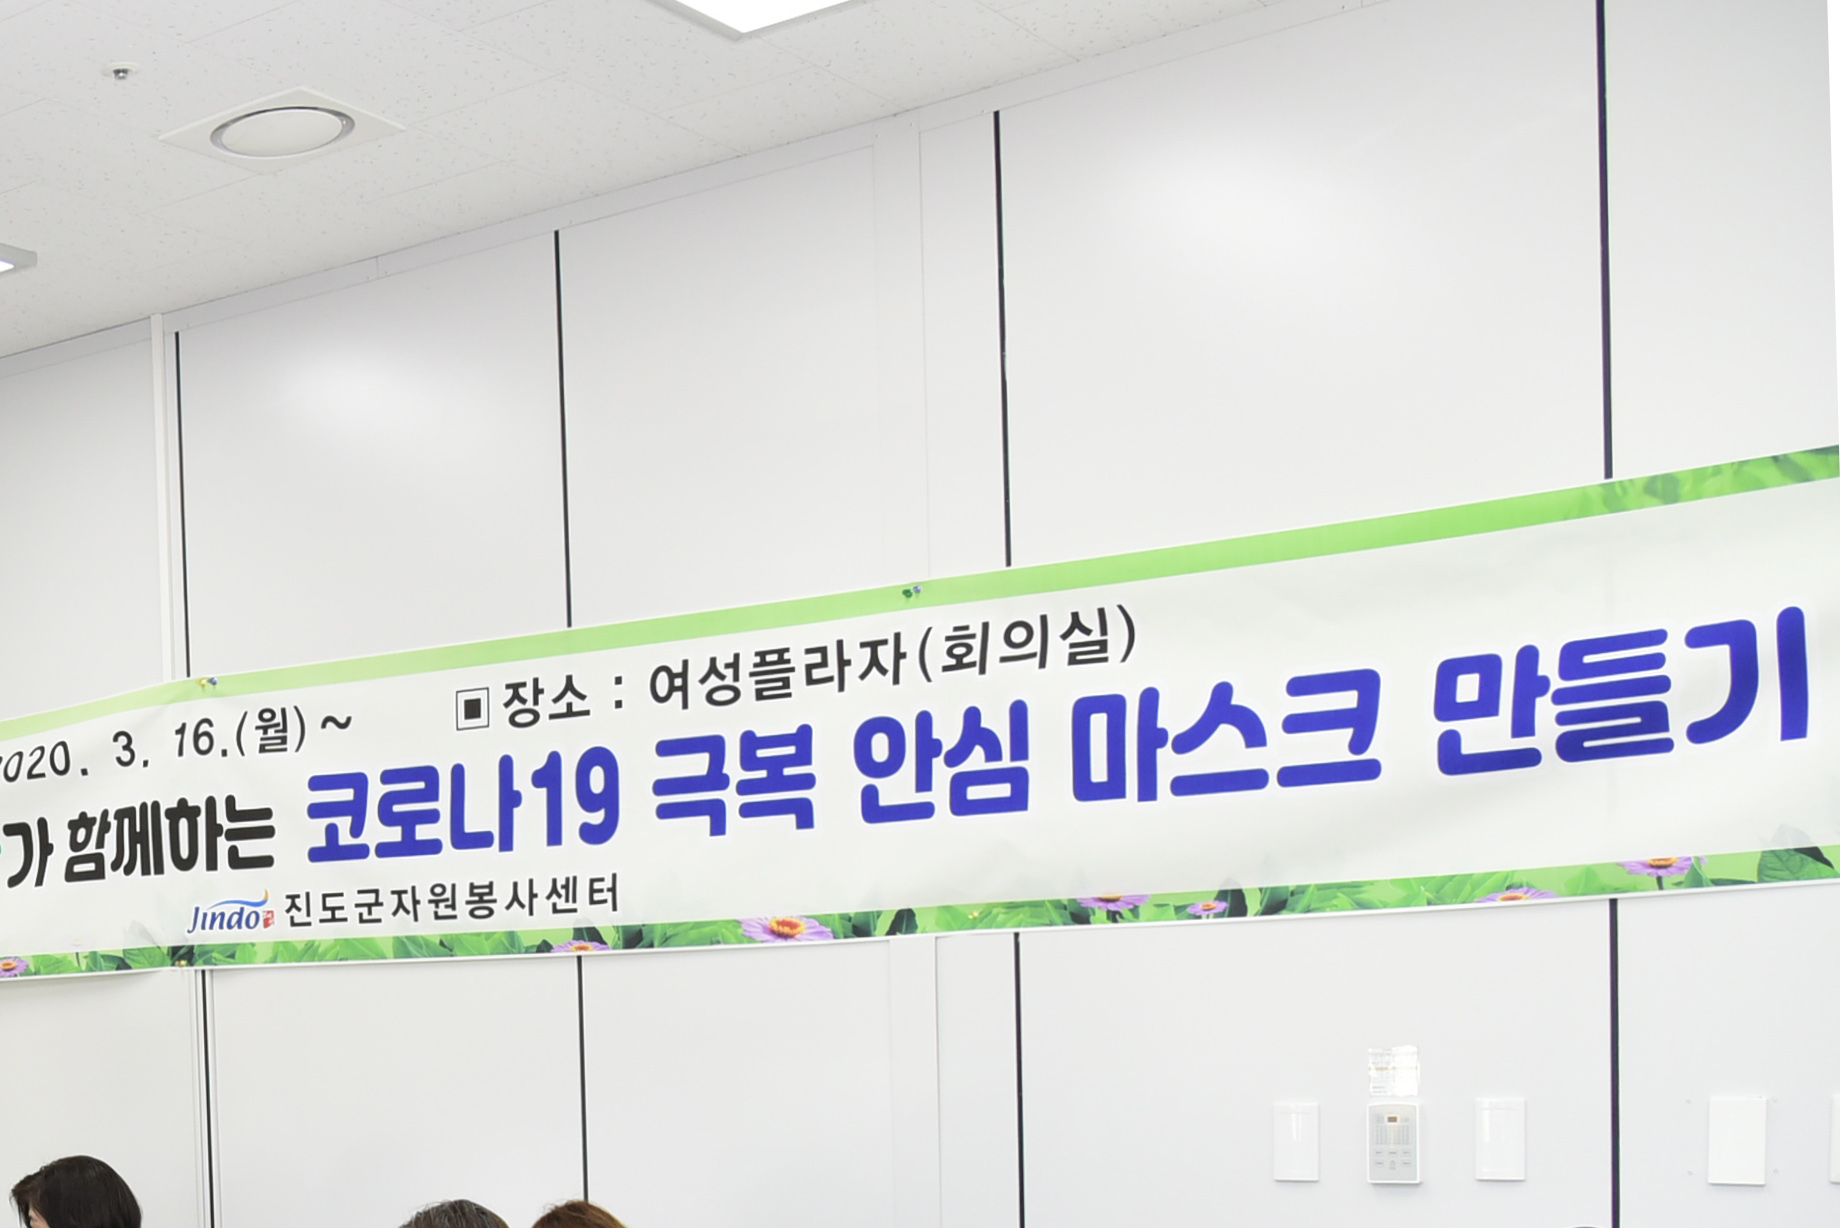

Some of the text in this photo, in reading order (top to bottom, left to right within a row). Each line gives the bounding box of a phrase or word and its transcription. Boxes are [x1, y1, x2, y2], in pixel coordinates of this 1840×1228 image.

[503, 675, 592, 729] 장소
[650, 604, 1136, 713] 여성플라자(회의실)
[65, 794, 276, 883] 함께하는
[306, 745, 622, 864] 코로나19
[652, 723, 817, 838] 극복
[853, 698, 1031, 826] 안심
[1071, 669, 1384, 803] 마스크
[1433, 605, 1810, 777] 만들기
[283, 873, 621, 928] 진도군자원봉사센터
